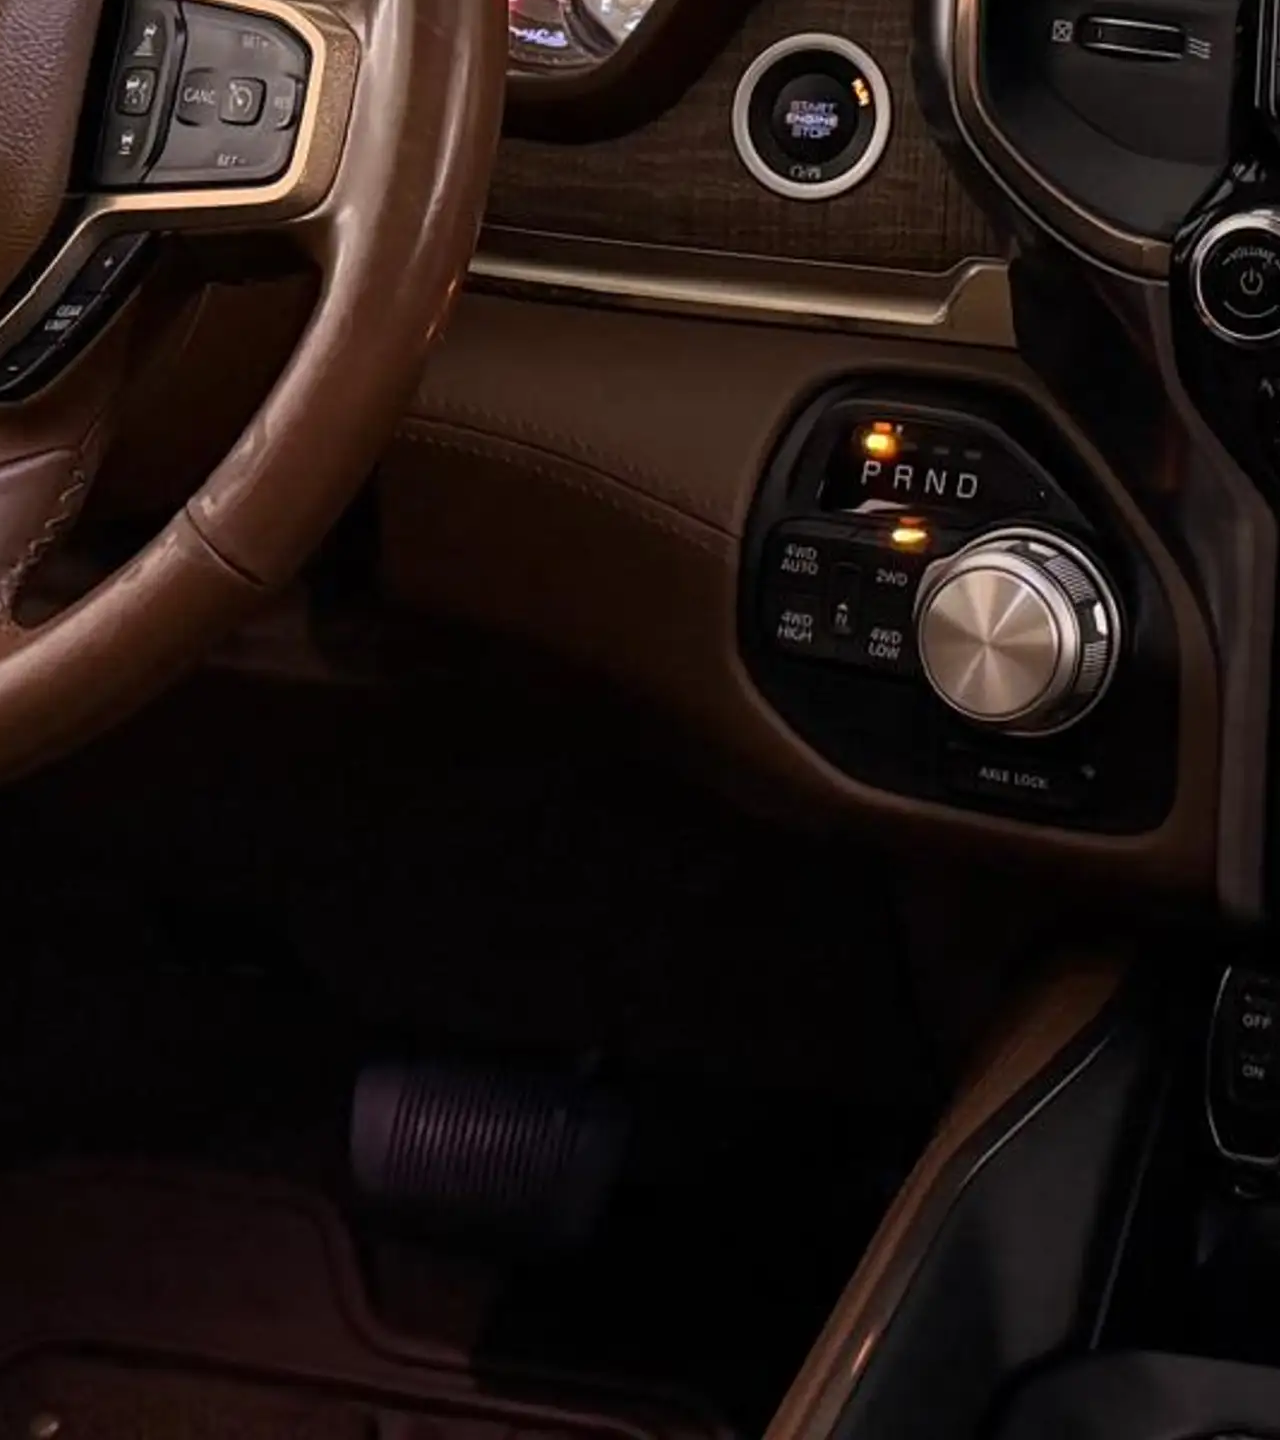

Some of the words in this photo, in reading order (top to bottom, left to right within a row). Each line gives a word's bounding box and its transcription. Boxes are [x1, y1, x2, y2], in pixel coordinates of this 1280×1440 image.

[861, 460, 881, 486] P
[893, 465, 914, 491] R
[924, 469, 948, 496] N
[956, 473, 979, 499] D
[785, 542, 818, 561] 4WD
[780, 558, 819, 576] AUTO
[875, 567, 908, 587] 2WD
[780, 610, 814, 627] 4WD
[776, 623, 812, 643] HIGH
[869, 627, 903, 645] 4WD
[867, 641, 901, 660] LOW
[979, 766, 1009, 784] AXLE
[1013, 770, 1049, 790] LOCK
[1242, 1014, 1272, 1029] OFF
[1242, 1064, 1266, 1079] ON
